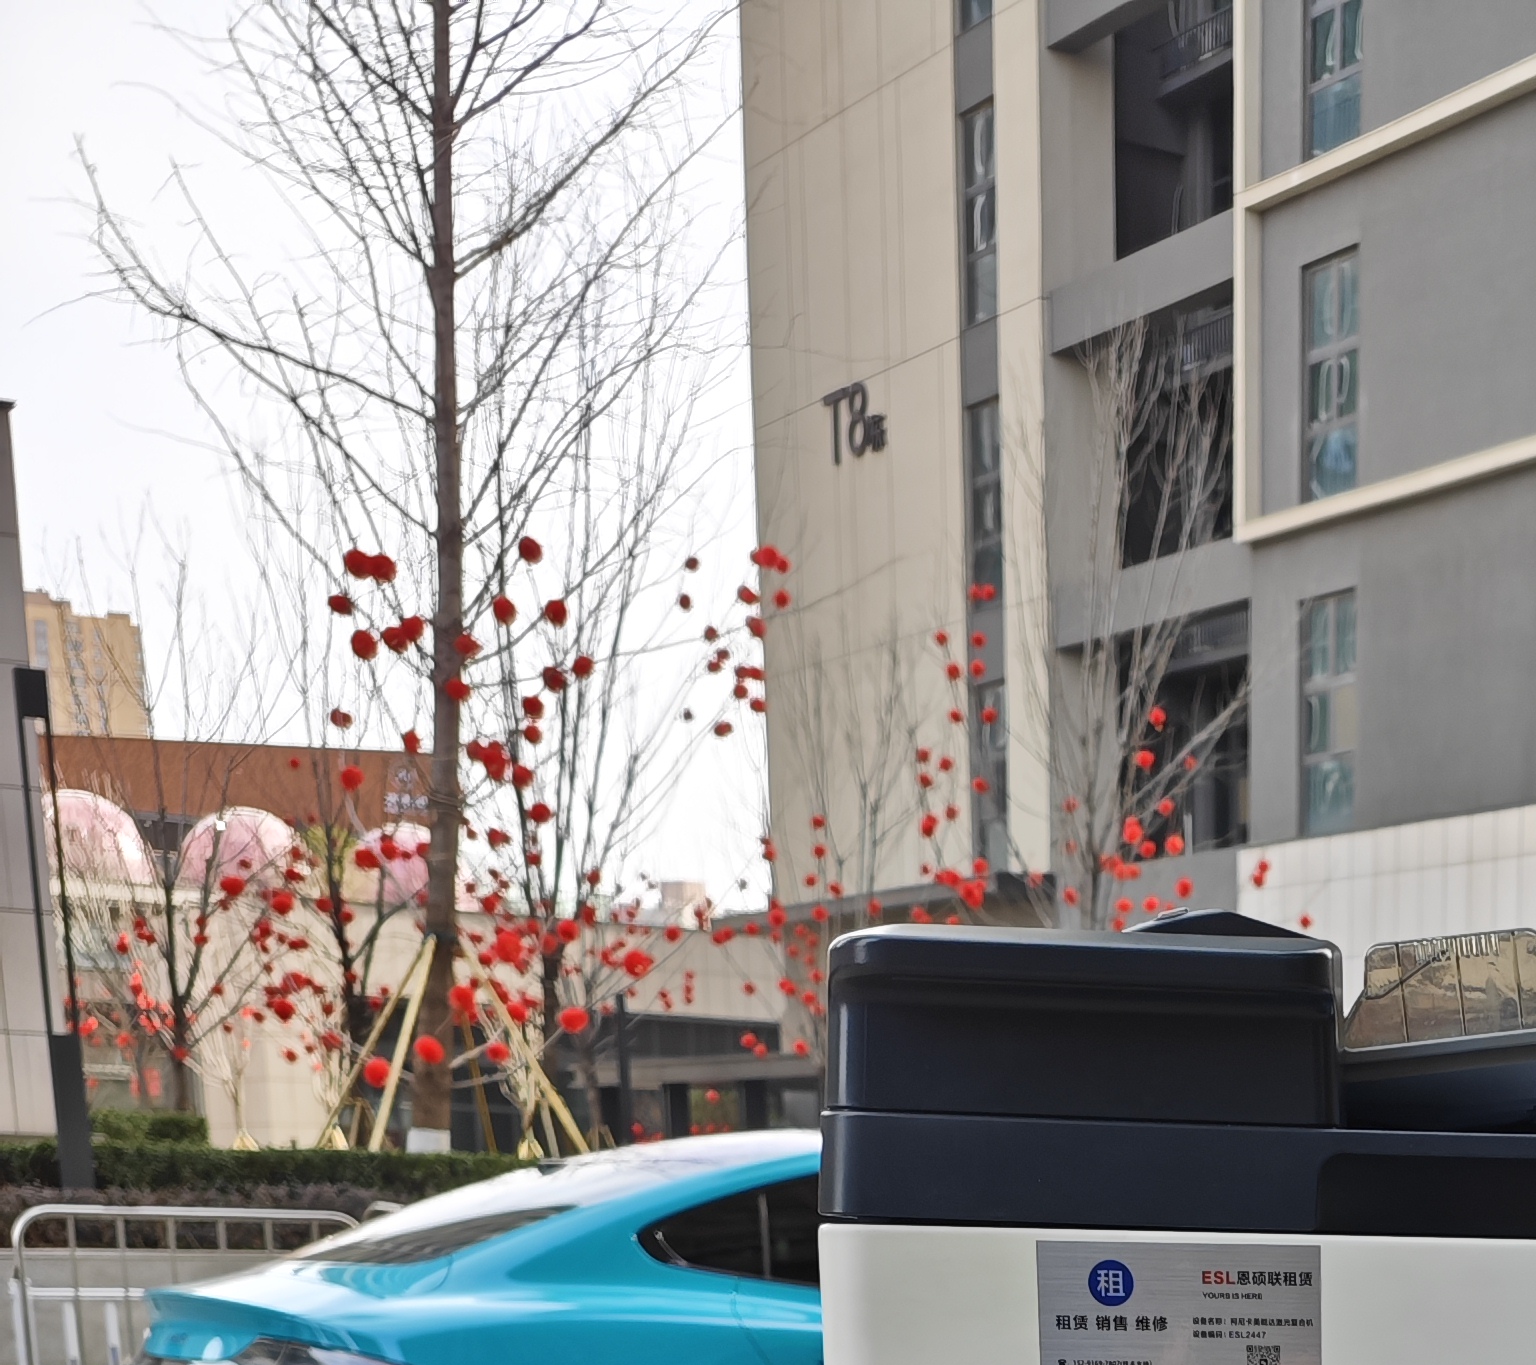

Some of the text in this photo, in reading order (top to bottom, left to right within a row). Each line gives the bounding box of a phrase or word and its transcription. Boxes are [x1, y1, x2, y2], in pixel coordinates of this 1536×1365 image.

[1096, 1269, 1126, 1297] 租
[1055, 1314, 1168, 1332] 租赁 销售 维修
